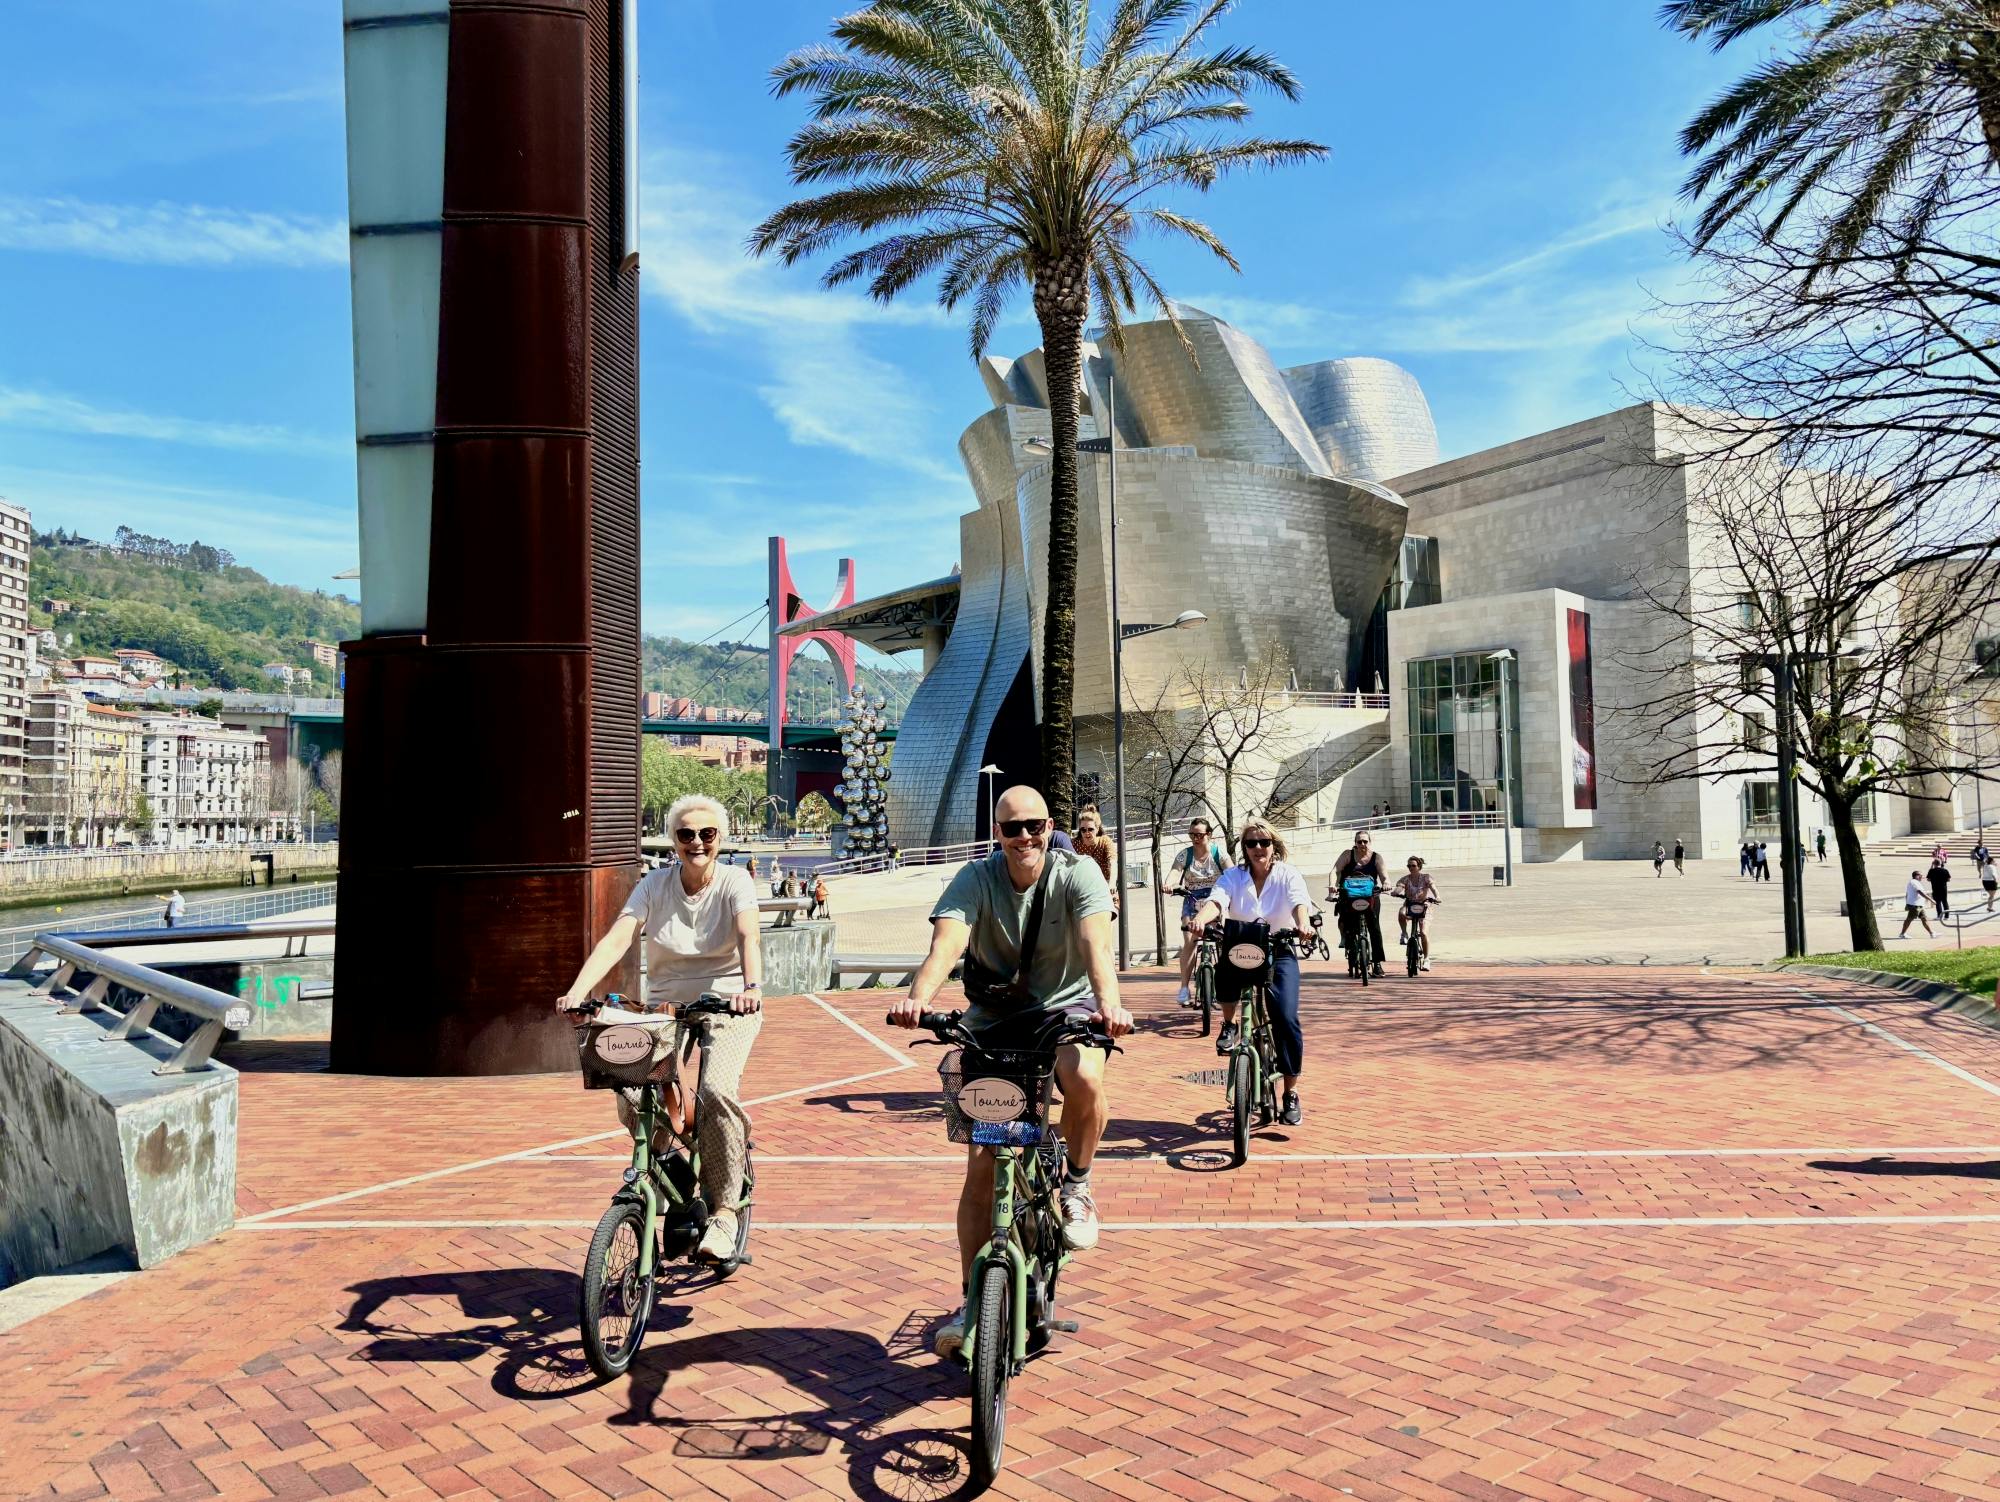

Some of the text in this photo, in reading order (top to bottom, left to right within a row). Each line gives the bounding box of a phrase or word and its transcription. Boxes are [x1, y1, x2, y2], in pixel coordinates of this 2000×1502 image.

[600, 1034, 646, 1051] Tourné
[965, 1088, 1019, 1107] Tourné
[997, 1203, 1009, 1213] 18
